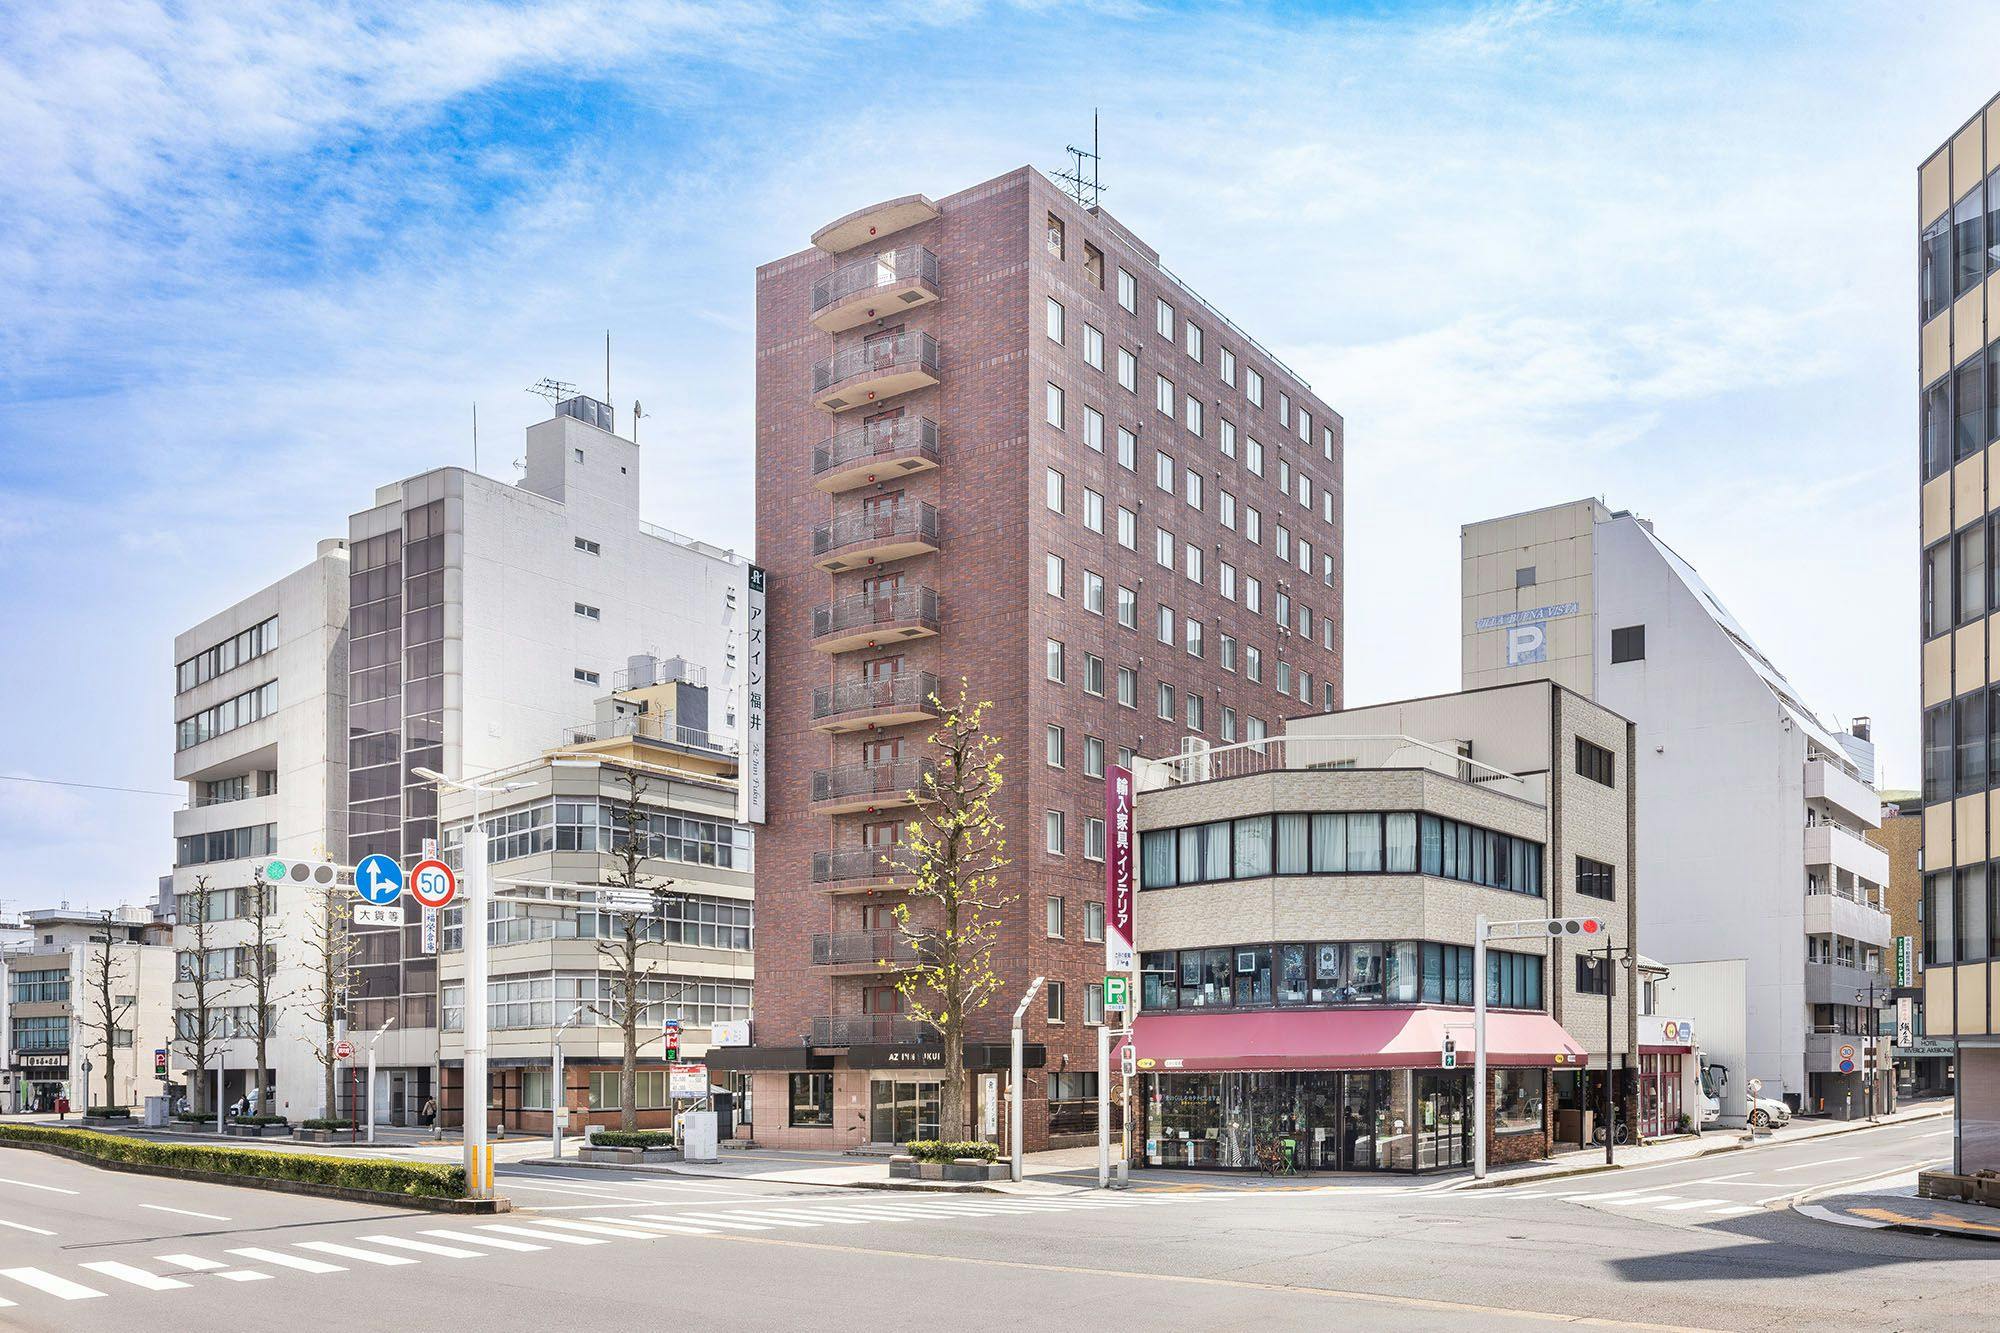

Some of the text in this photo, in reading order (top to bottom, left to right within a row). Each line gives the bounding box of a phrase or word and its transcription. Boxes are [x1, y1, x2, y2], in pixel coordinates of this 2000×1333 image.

[1507, 609, 1543, 624] BUENA
[1547, 602, 1578, 616] VISTA
[1509, 626, 1543, 664] P
[750, 606, 762, 731] アズイン福井
[1116, 777, 1129, 928] 輸入家具・インテリア
[421, 873, 445, 895] 50
[360, 910, 399, 922] 大貨等
[1108, 979, 1125, 1002] P
[888, 1053, 899, 1061] AZ
